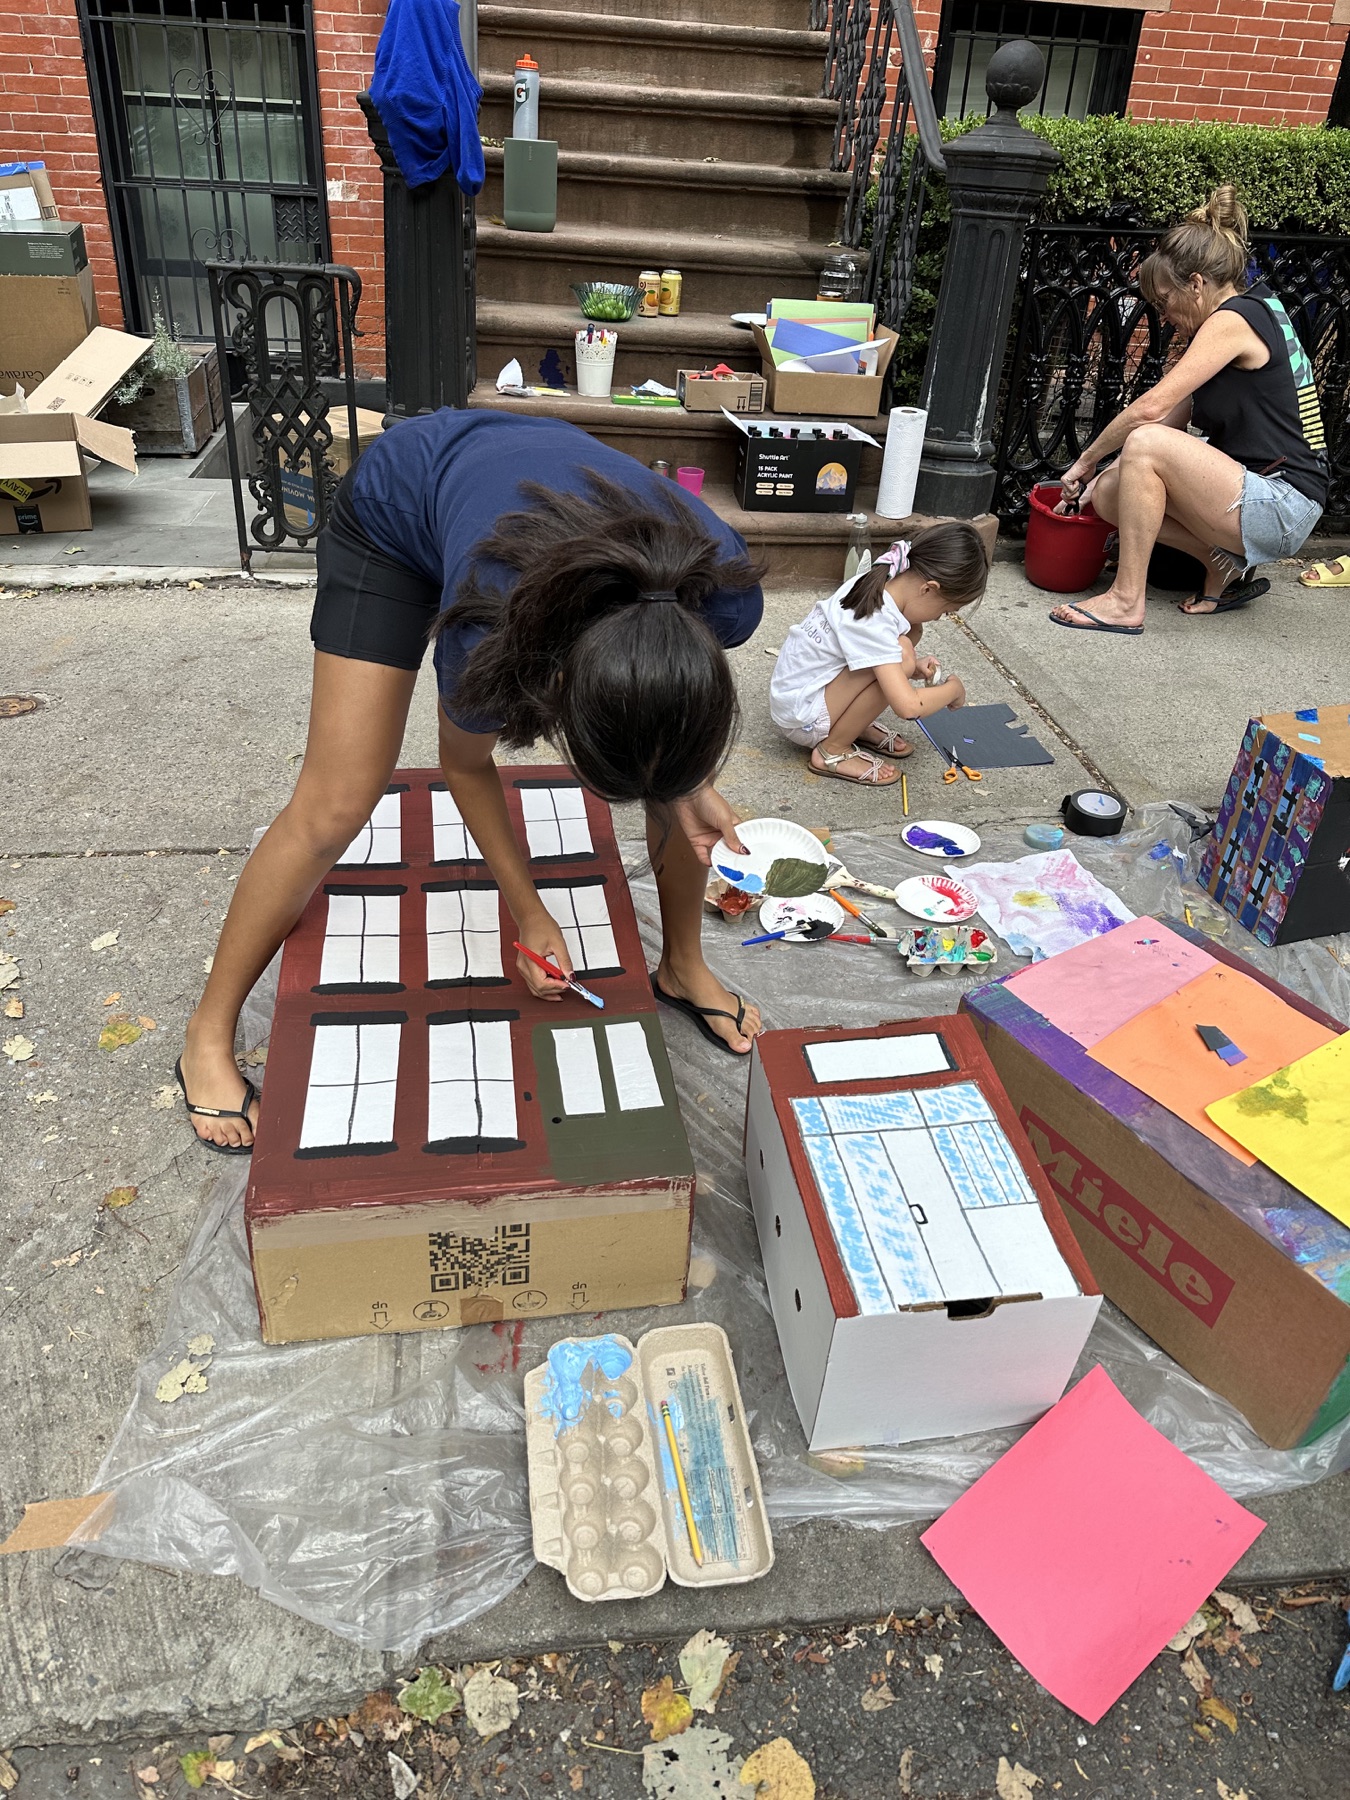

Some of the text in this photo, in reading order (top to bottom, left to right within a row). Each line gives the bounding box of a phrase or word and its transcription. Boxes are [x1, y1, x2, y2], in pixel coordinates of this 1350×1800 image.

[514, 82, 527, 103] G
[758, 453, 779, 461] Shuttle
[2, 479, 30, 499] HEAVY
[1026, 1119, 1213, 1306] Miele
[571, 1281, 588, 1290] up
[371, 1301, 389, 1310] up
